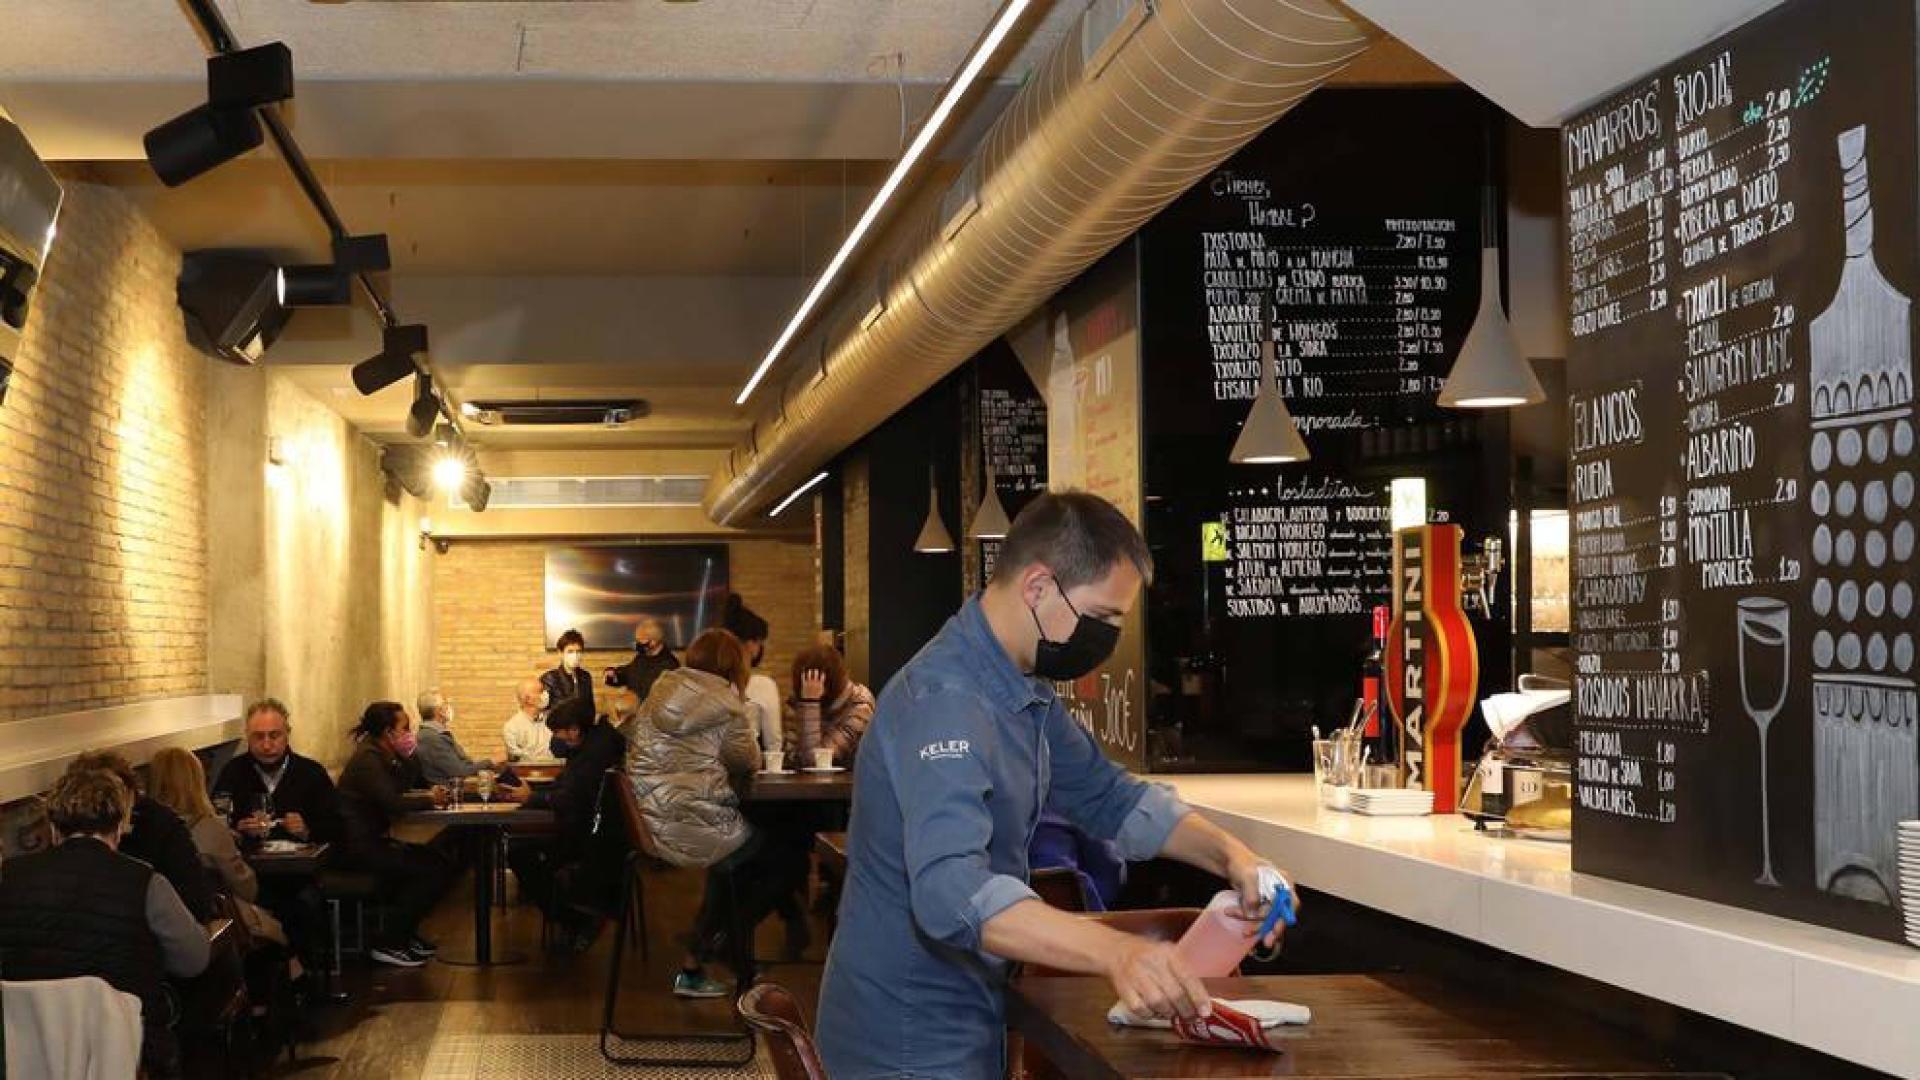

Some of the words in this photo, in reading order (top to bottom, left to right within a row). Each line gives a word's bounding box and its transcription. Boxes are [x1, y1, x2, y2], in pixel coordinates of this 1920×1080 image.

[1678, 53, 1732, 124] RIOJA
[1568, 92, 1660, 177] NAVARROS
[1680, 198, 1720, 245] RIBERA
[1742, 170, 1778, 213] DUERO
[1576, 458, 1614, 503] RUEDA
[1687, 422, 1755, 481] ALBARIÑO
[1688, 510, 1753, 564] MONTILLA
[1703, 558, 1754, 590] MORILES
[1405, 547, 1423, 790] MARTINI
[920, 739, 970, 760] KELER
